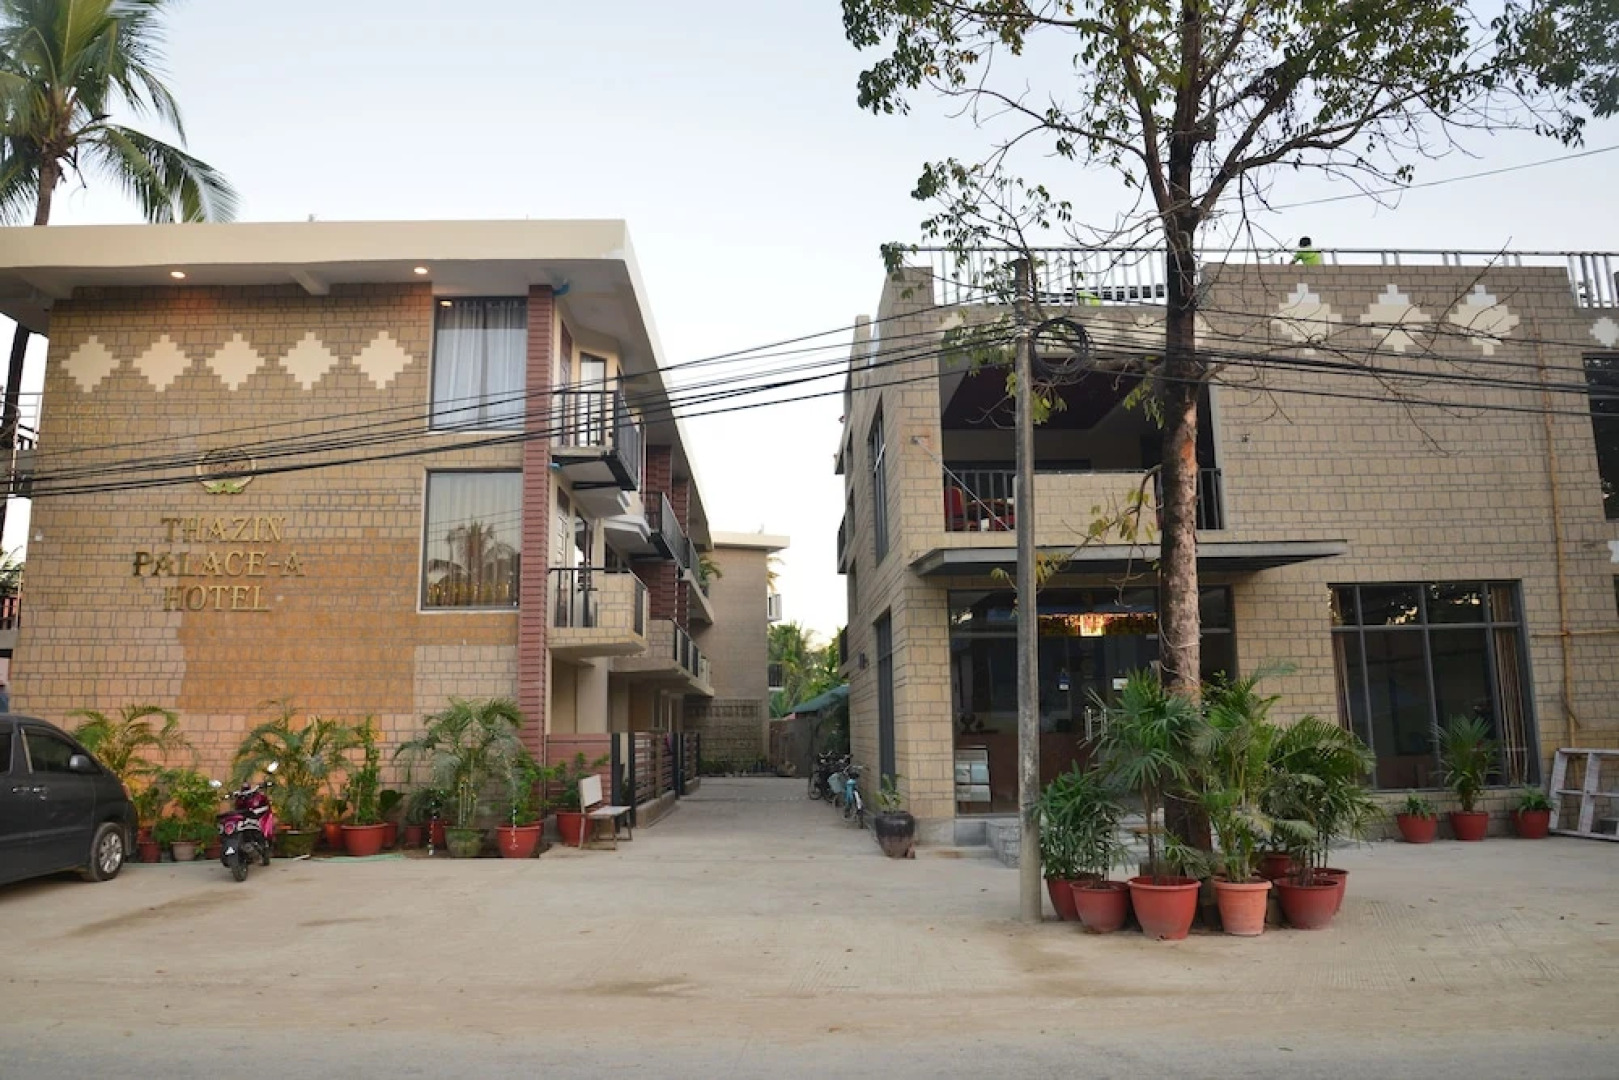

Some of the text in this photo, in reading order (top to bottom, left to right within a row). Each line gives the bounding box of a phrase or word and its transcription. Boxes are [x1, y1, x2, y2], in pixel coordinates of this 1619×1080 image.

[160, 517, 286, 543] THAZIN
[132, 551, 305, 577] PALACE-A
[163, 585, 271, 613] HOTEL
